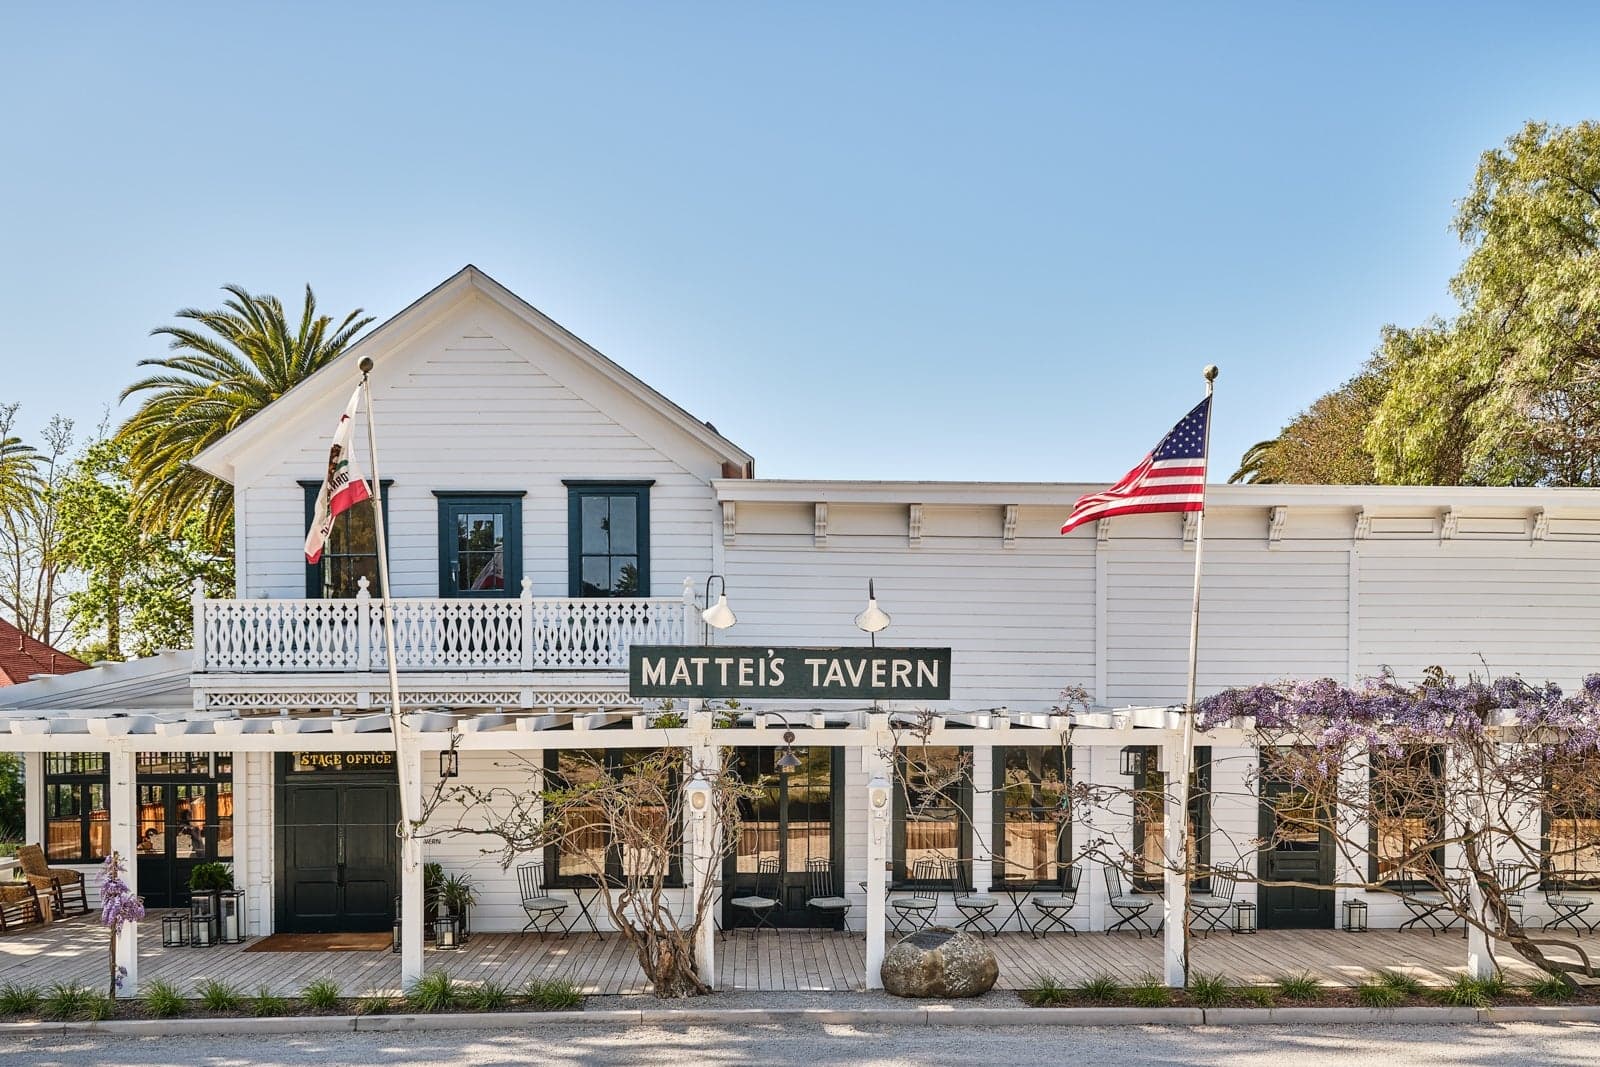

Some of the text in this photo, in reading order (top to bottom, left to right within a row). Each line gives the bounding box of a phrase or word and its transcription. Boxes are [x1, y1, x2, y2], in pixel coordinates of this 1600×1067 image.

[641, 649, 939, 688] MATTEI'S TAVERN
[300, 754, 391, 767] STAGE OFFICE
